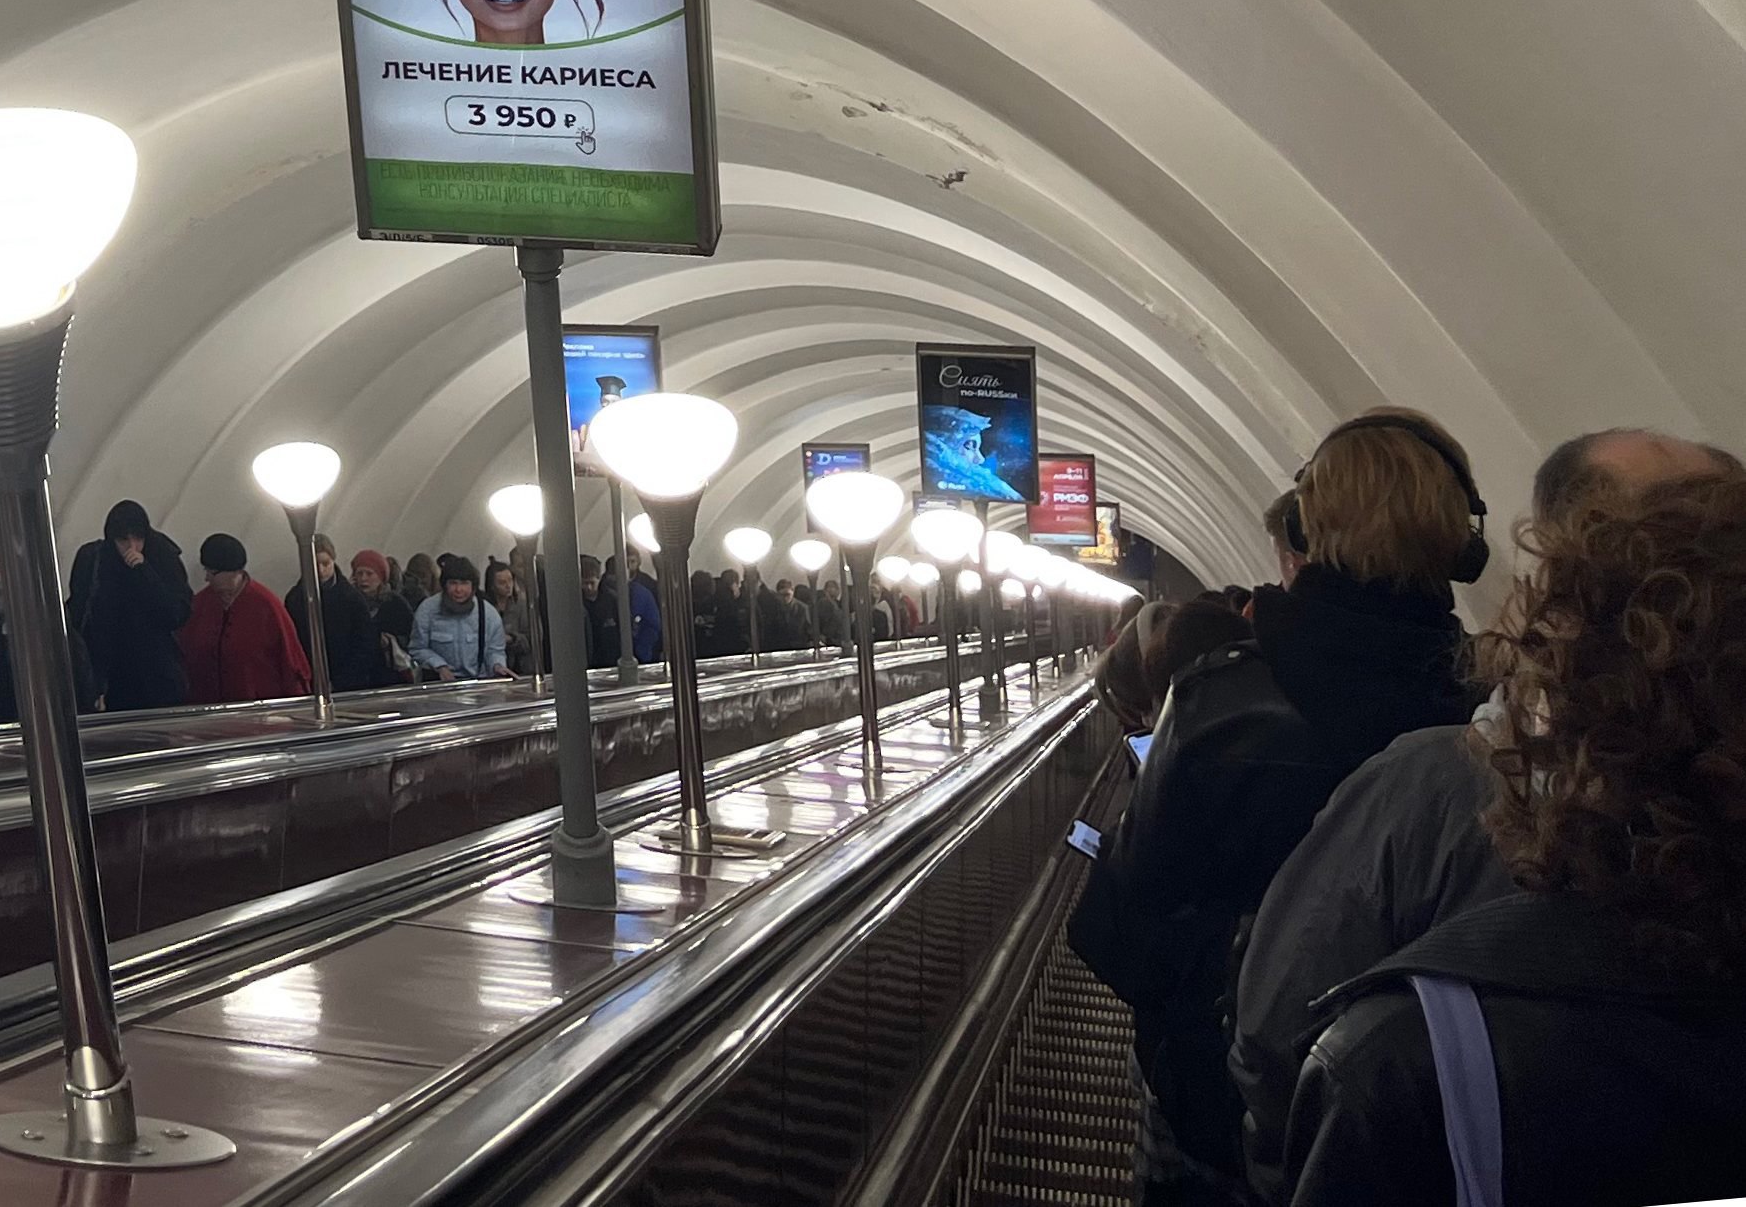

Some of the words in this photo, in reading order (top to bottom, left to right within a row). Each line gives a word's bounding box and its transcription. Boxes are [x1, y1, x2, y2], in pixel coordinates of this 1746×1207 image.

[382, 61, 512, 84] ЛЕЧЕНИЕ
[521, 65, 657, 89] КАРИЕСА
[467, 103, 486, 126] 3
[495, 105, 556, 128] 950
